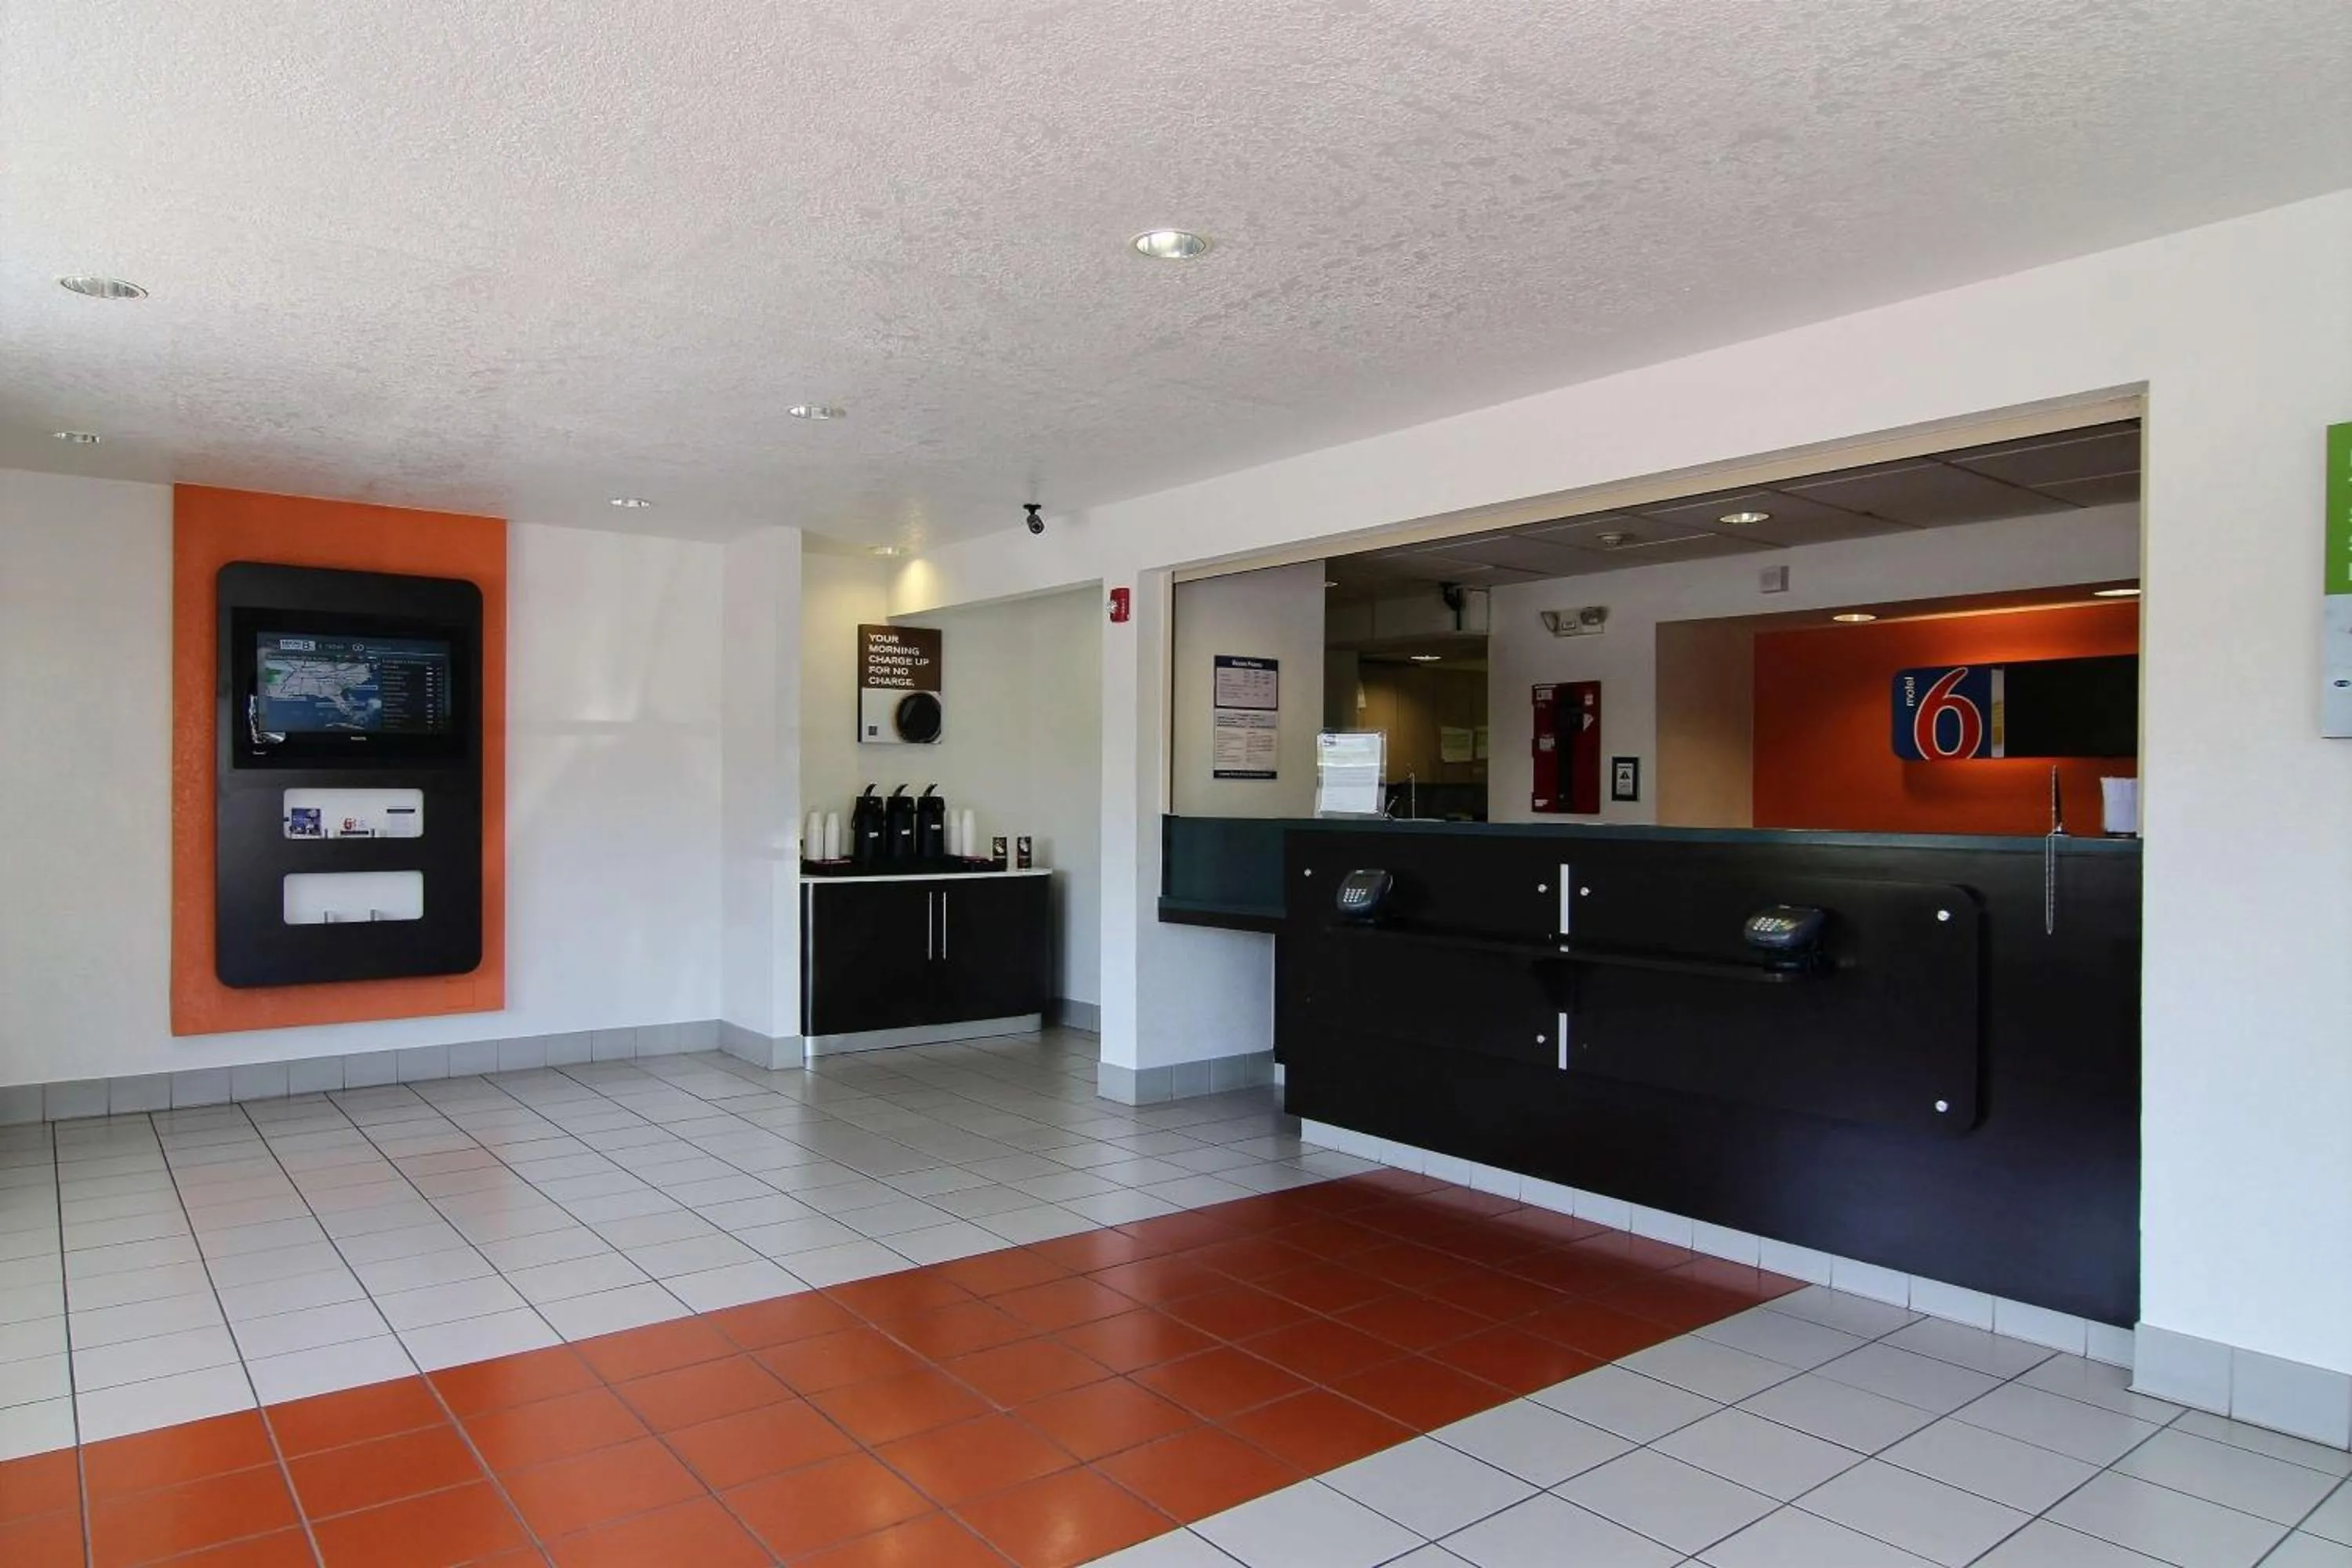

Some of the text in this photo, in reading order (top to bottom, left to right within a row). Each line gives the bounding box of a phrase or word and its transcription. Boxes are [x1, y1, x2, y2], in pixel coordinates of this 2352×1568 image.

[868, 633, 899, 643] YOUR
[868, 644, 920, 655] MORNING
[868, 655, 930, 666] CHARGE UP
[868, 666, 909, 676] FOR NO
[868, 676, 915, 687] CHARGE.
[1904, 666, 1983, 760] motel 6
